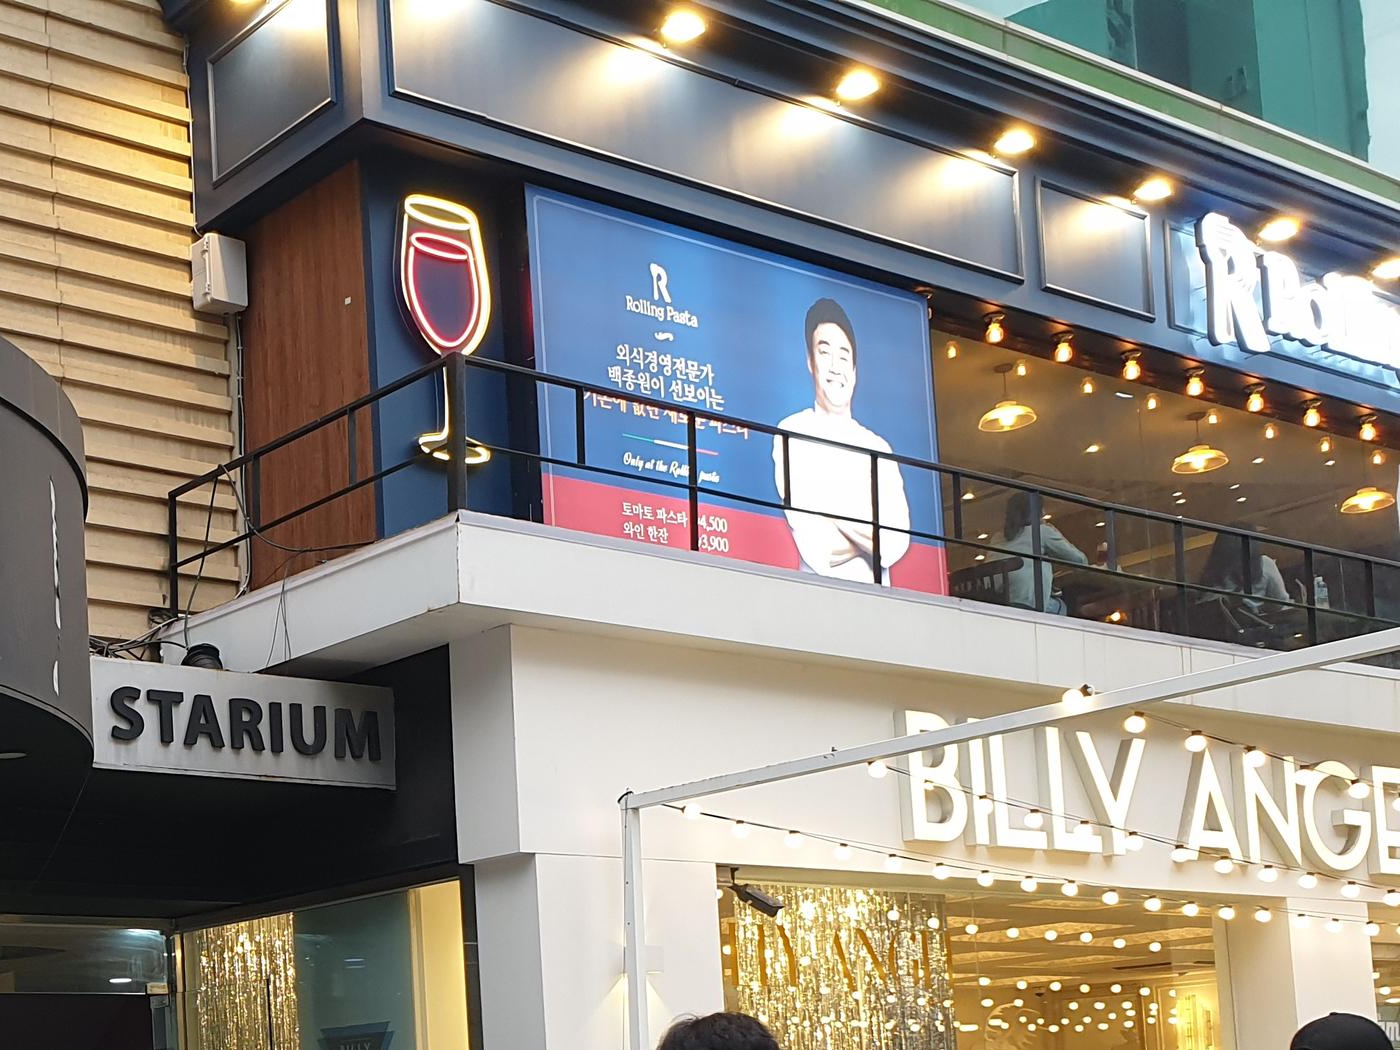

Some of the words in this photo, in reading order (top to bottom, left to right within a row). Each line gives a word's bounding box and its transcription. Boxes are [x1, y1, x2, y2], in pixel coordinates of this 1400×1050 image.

[625, 295, 665, 321] Rolling
[666, 305, 699, 328] Pasta
[616, 344, 715, 386] 외식경영전문가
[607, 366, 666, 399] 백종원이
[669, 380, 725, 411] 선보이는
[623, 452, 644, 471] Only
[622, 502, 654, 520] 토마토
[656, 508, 688, 528] 파스타
[698, 517, 727, 533] 4,500
[623, 521, 645, 540] 와인
[648, 526, 669, 544] 한잔
[698, 535, 729, 553] 3,900
[110, 685, 382, 762] STARIUM
[896, 709, 1146, 856] BILLY
